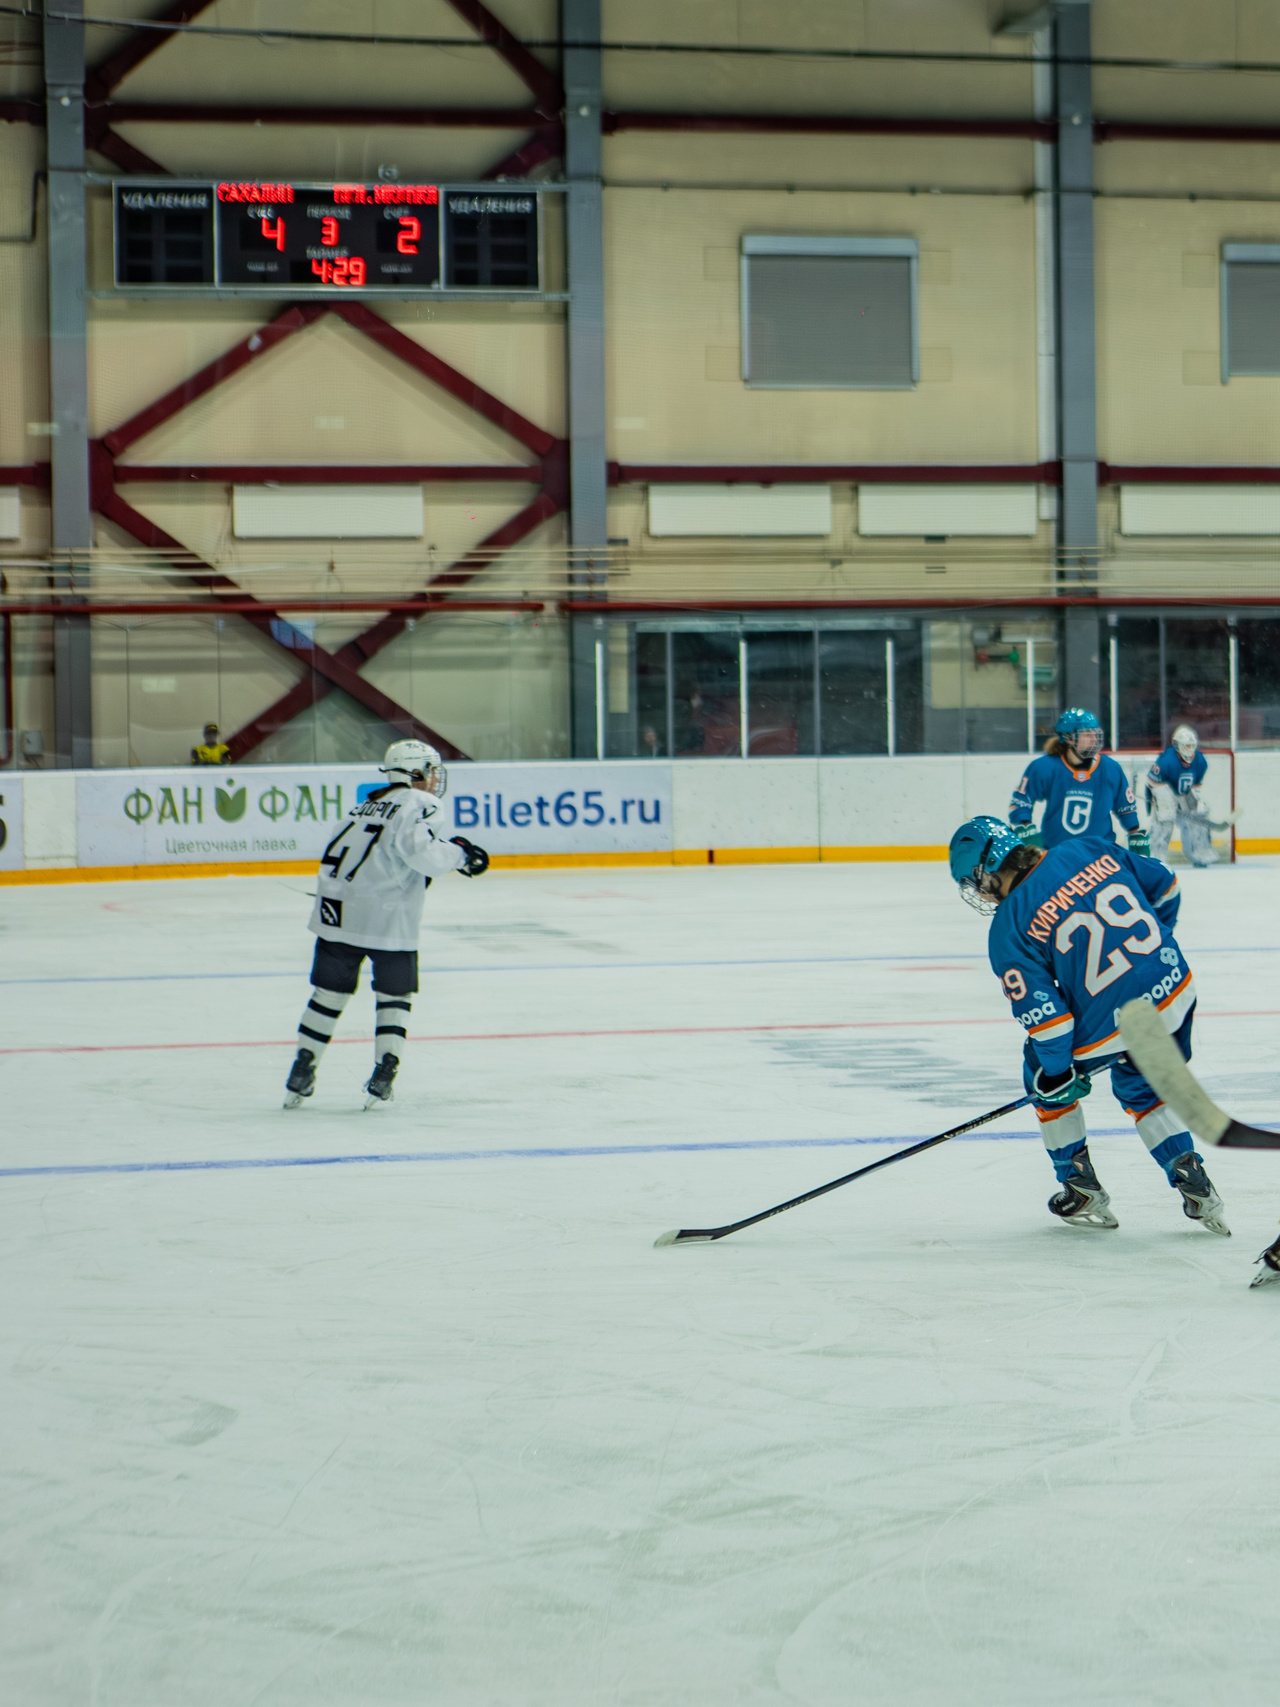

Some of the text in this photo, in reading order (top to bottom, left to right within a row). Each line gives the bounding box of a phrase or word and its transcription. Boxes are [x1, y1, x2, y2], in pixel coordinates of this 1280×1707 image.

[122, 192, 208, 210] УДАЛЕНИЯ
[261, 216, 285, 252] 4
[321, 216, 339, 246] 3
[397, 216, 421, 254] 2
[311, 257, 366, 286] 4:29
[124, 785, 342, 825] ФАН ФАН
[453, 791, 661, 829] Bilet65.ru
[166, 837, 297, 854] Цветочная лавка
[321, 820, 385, 882] 47
[1027, 854, 1121, 944] КИРИЧЕНКО
[1055, 883, 1162, 997] 29
